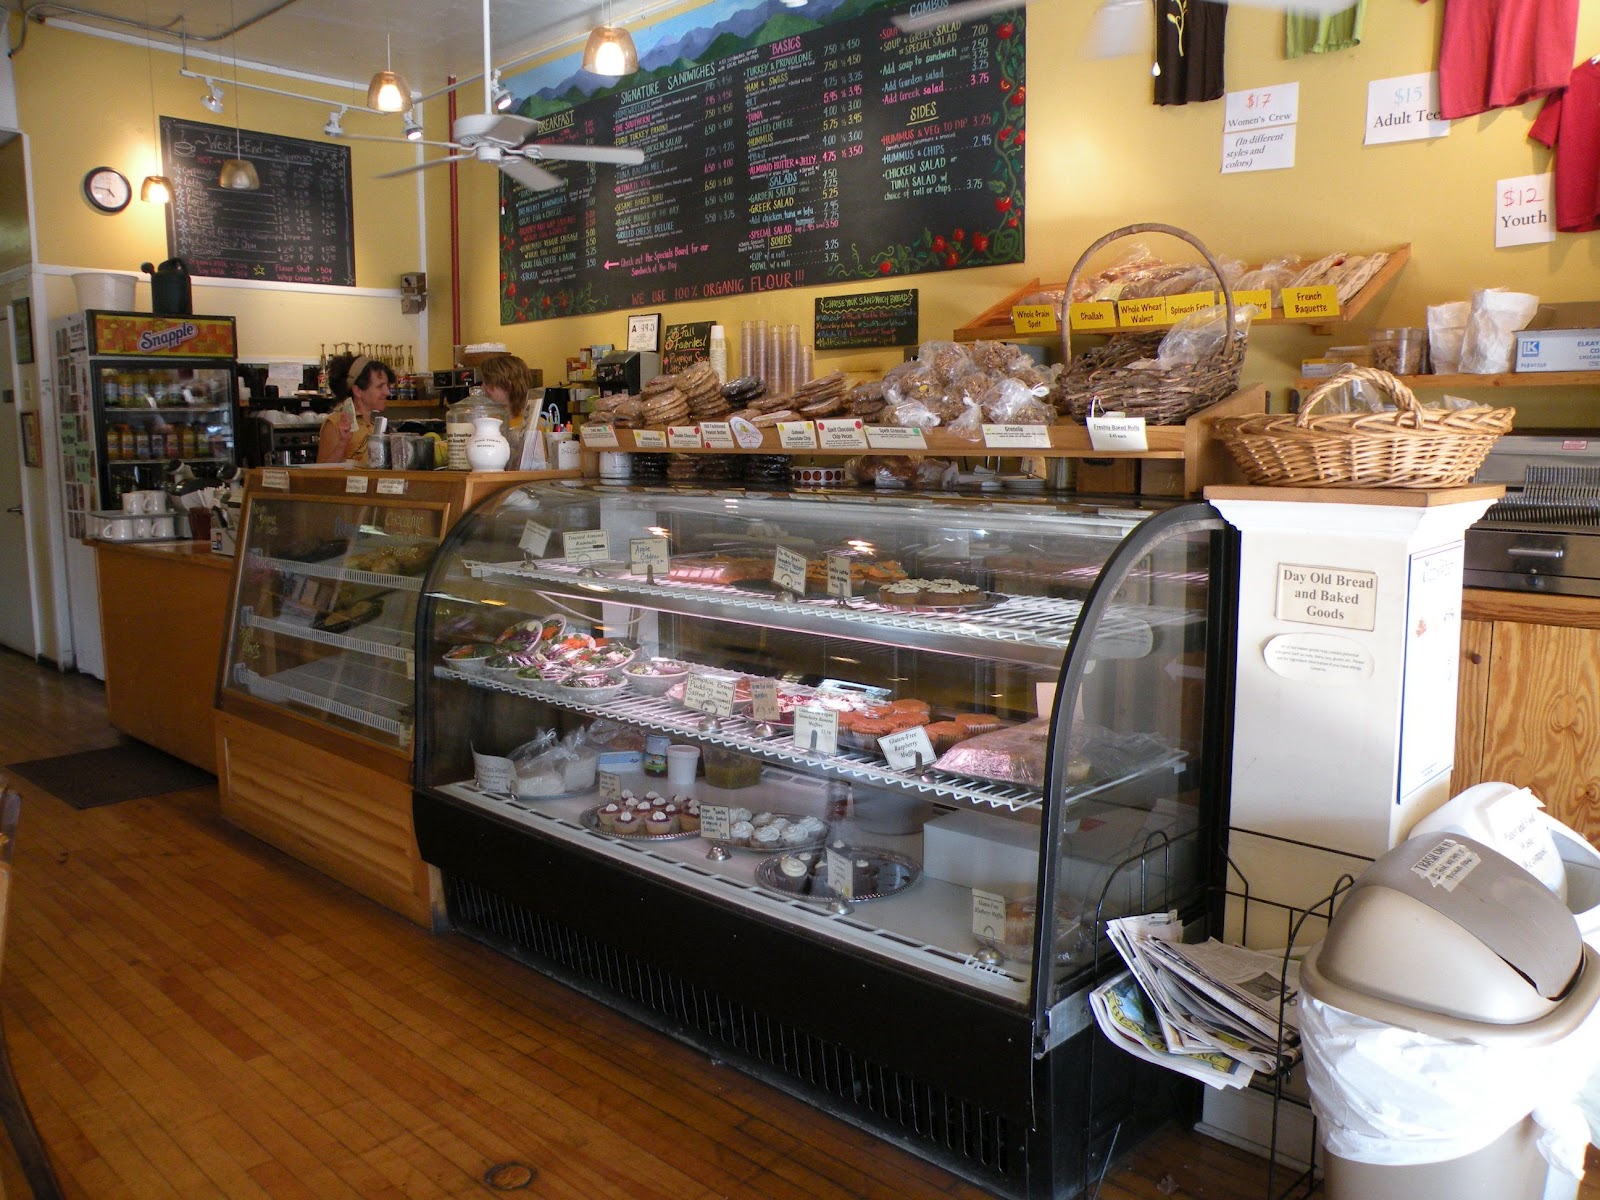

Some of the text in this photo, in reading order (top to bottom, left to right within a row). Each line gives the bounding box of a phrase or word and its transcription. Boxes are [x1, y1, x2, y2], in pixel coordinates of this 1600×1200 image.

[910, 0, 949, 18] COMBOS
[772, 36, 802, 55] BASICS
[884, 21, 961, 52] SOUP GREEK SALAD
[906, 24, 989, 56] SPECIAL SALAD 7.00
[746, 63, 768, 77] TURKEY
[776, 51, 813, 69] PROVOLONE
[847, 39, 860, 49] 4.50
[883, 38, 989, 76] Add soup to sandwich 2.50
[747, 80, 759, 93] HAM
[769, 73, 789, 86] SWISS
[847, 55, 861, 66] 4.50
[884, 68, 944, 93] Add Garden salad
[621, 82, 660, 105] SIGNATURE
[668, 62, 715, 90] SANDWICHES
[885, 72, 990, 105] Add Greek salad 3.75
[824, 85, 862, 104] 5.95 3.95
[1246, 92, 1272, 110] $17
[1394, 86, 1423, 105] $15
[749, 100, 862, 138] GRILLED CHEESE 3.00
[910, 102, 937, 122] SIDES
[1228, 112, 1292, 129] Women's Crew
[1373, 108, 1441, 130] Adult Tee
[538, 110, 575, 133] BREAKFAST
[705, 124, 715, 136] 6.50
[749, 133, 774, 147] HUMMUS
[824, 120, 838, 131] 5.75
[849, 112, 862, 125] 3.95
[883, 130, 915, 146] HUMMUS
[924, 124, 940, 136] VEG
[944, 121, 953, 131] TO
[955, 118, 968, 130] DIP
[973, 114, 992, 126] 3.25
[207, 135, 263, 154] West End
[630, 130, 649, 142] TURKEY
[849, 131, 863, 141] 3.00
[1235, 132, 1284, 148] (In different
[883, 135, 992, 164] HUMMUS CHIPS 2.95
[1226, 145, 1266, 161] styles and
[705, 163, 716, 174] 6.50
[750, 146, 863, 175] ALMOND BUTTER JELLY 4.75 3.50
[885, 157, 946, 180] CHICKEN SALAD
[1226, 158, 1253, 171] colors)
[770, 172, 798, 188] SALADS
[891, 174, 937, 191] TUNA SALAD
[751, 186, 796, 203] GARDEN SALAD
[885, 190, 901, 201] choice
[914, 186, 925, 197] roll
[935, 184, 952, 195] chips
[967, 179, 983, 190] 3.75
[1503, 188, 1544, 208] $12
[751, 189, 839, 214] GREEK SALAD 5.25
[655, 222, 674, 233] DELUXE
[1501, 210, 1548, 229] Youth
[560, 233, 579, 243] SAUSAGE
[751, 225, 792, 239] SPECIAL SALAD
[771, 234, 793, 247] SOUPS
[621, 257, 634, 268] Check
[635, 256, 644, 266] out
[645, 253, 653, 263] the
[654, 249, 673, 263] Specials
[674, 244, 689, 257] Board
[700, 244, 710, 253] our
[752, 239, 839, 261] CUP 3.25
[632, 262, 678, 277] Sandwich of Day
[752, 253, 839, 271] BOWL 3.75
[632, 272, 793, 305] WE USE 100% ORGANIC FLOUR
[1297, 292, 1322, 302] French
[1081, 312, 1104, 321] Challah
[1121, 304, 1162, 314] Whole Wheat
[1171, 305, 1195, 314] Spinach
[1294, 303, 1328, 314] Baguette
[1028, 320, 1042, 329] Spelt
[1131, 315, 1154, 324] Walnut
[141, 322, 194, 350] Snapple
[681, 325, 695, 337] Fall
[1284, 570, 1374, 589] Day Old Bread
[1295, 589, 1359, 605] and Baked
[1307, 606, 1345, 620] Goods
[1414, 854, 1440, 871] TRASH
